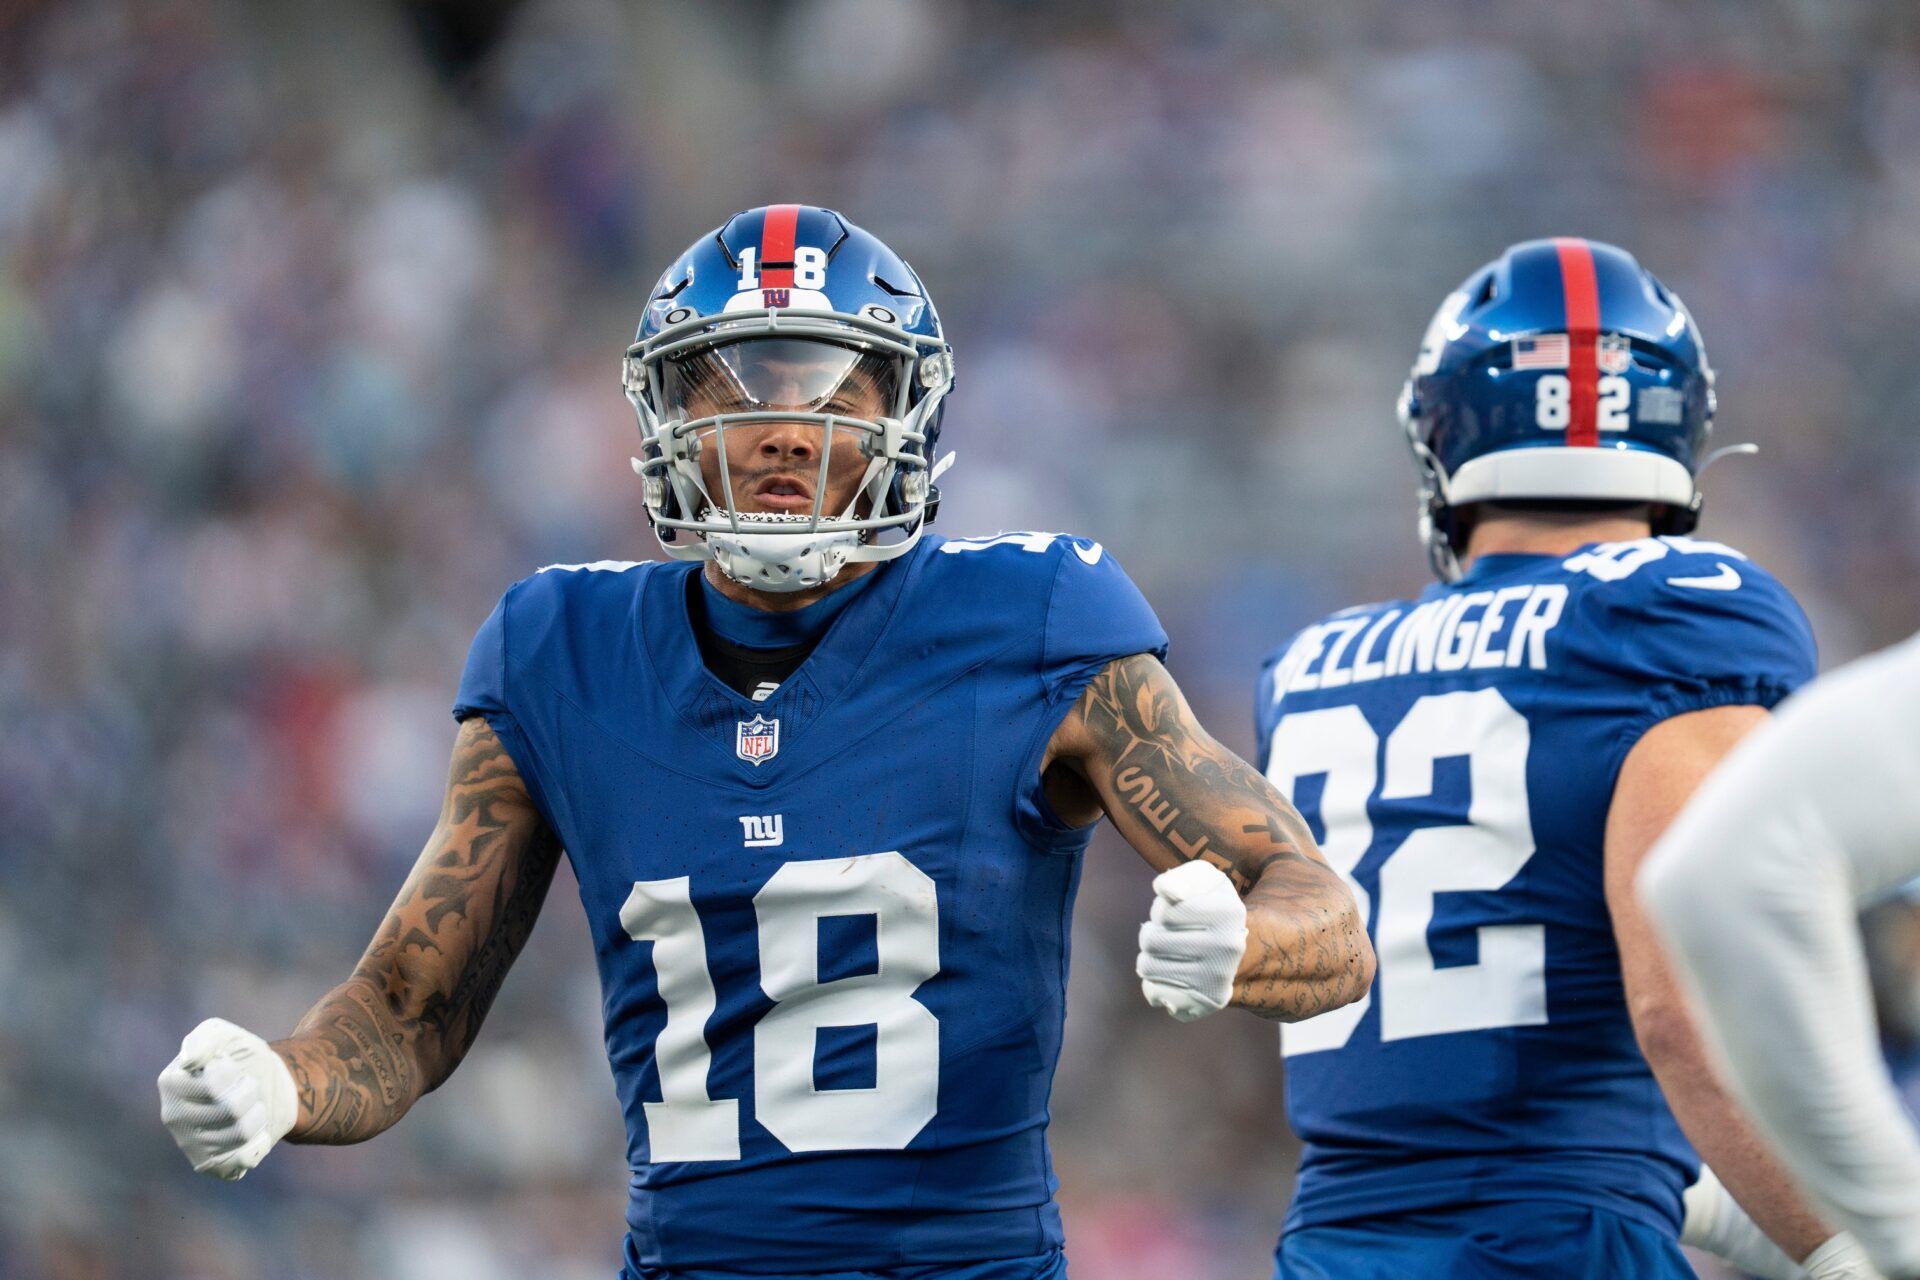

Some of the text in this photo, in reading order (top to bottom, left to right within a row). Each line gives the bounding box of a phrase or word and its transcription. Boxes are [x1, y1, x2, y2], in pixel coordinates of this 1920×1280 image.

[744, 735, 772, 756] NFL
[1263, 686, 1549, 1057] 82
[618, 850, 941, 1164] 18
